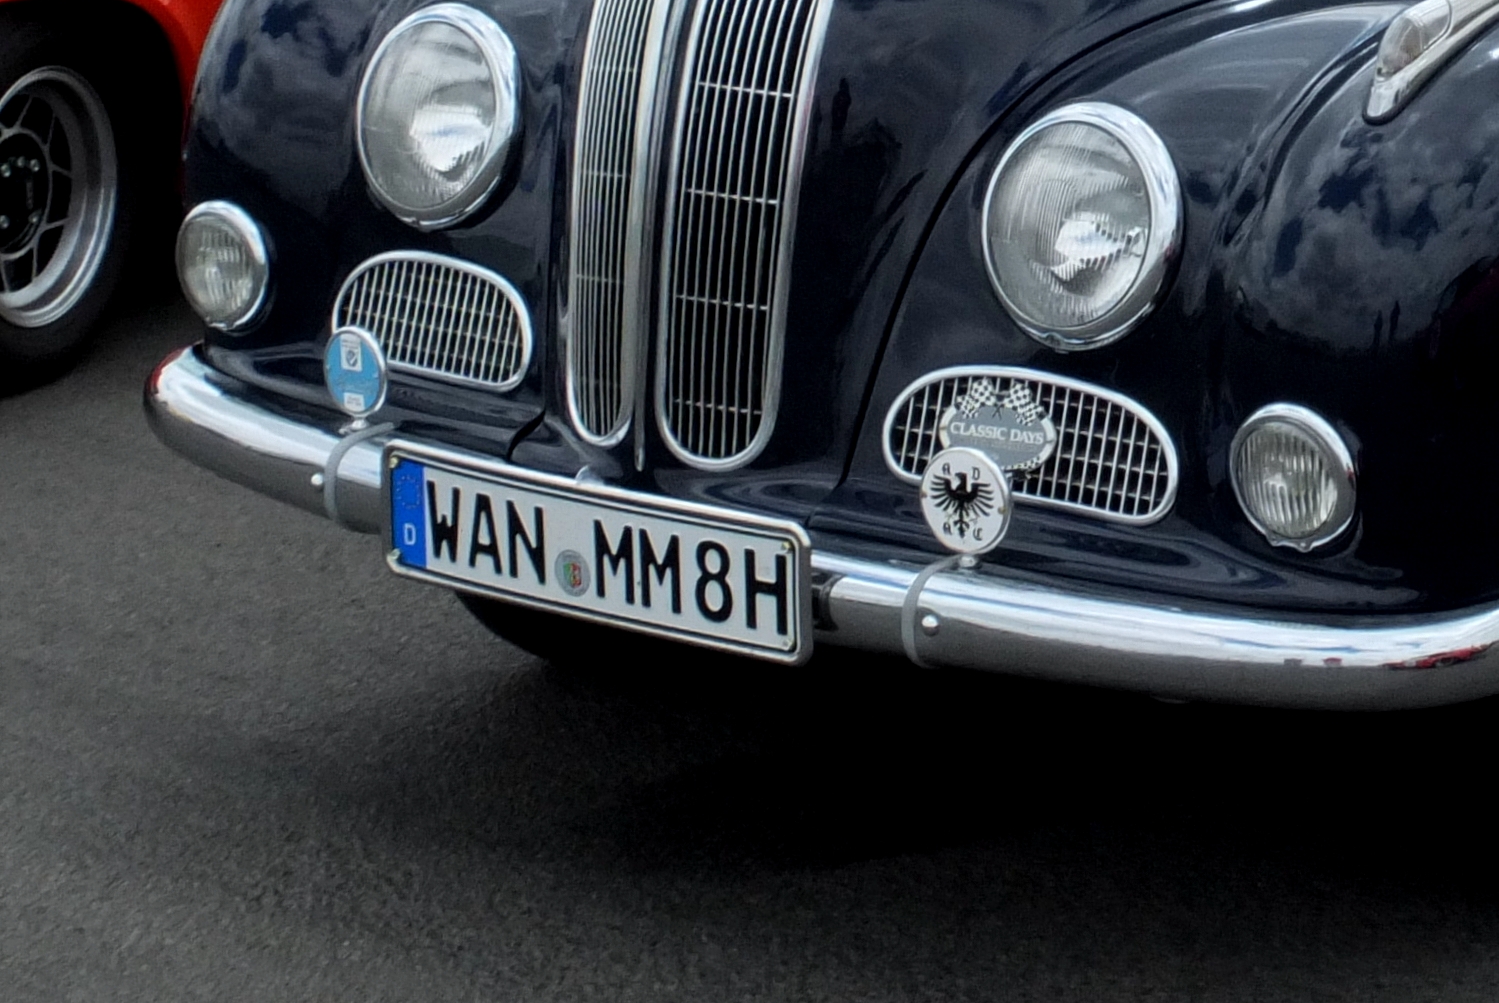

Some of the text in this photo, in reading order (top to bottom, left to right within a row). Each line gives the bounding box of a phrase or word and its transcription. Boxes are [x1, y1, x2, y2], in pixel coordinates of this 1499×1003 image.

[950, 421, 1008, 440] CLASSIC
[1010, 428, 1044, 445] DAYS
[403, 522, 417, 546] D
[427, 480, 547, 585] WAN
